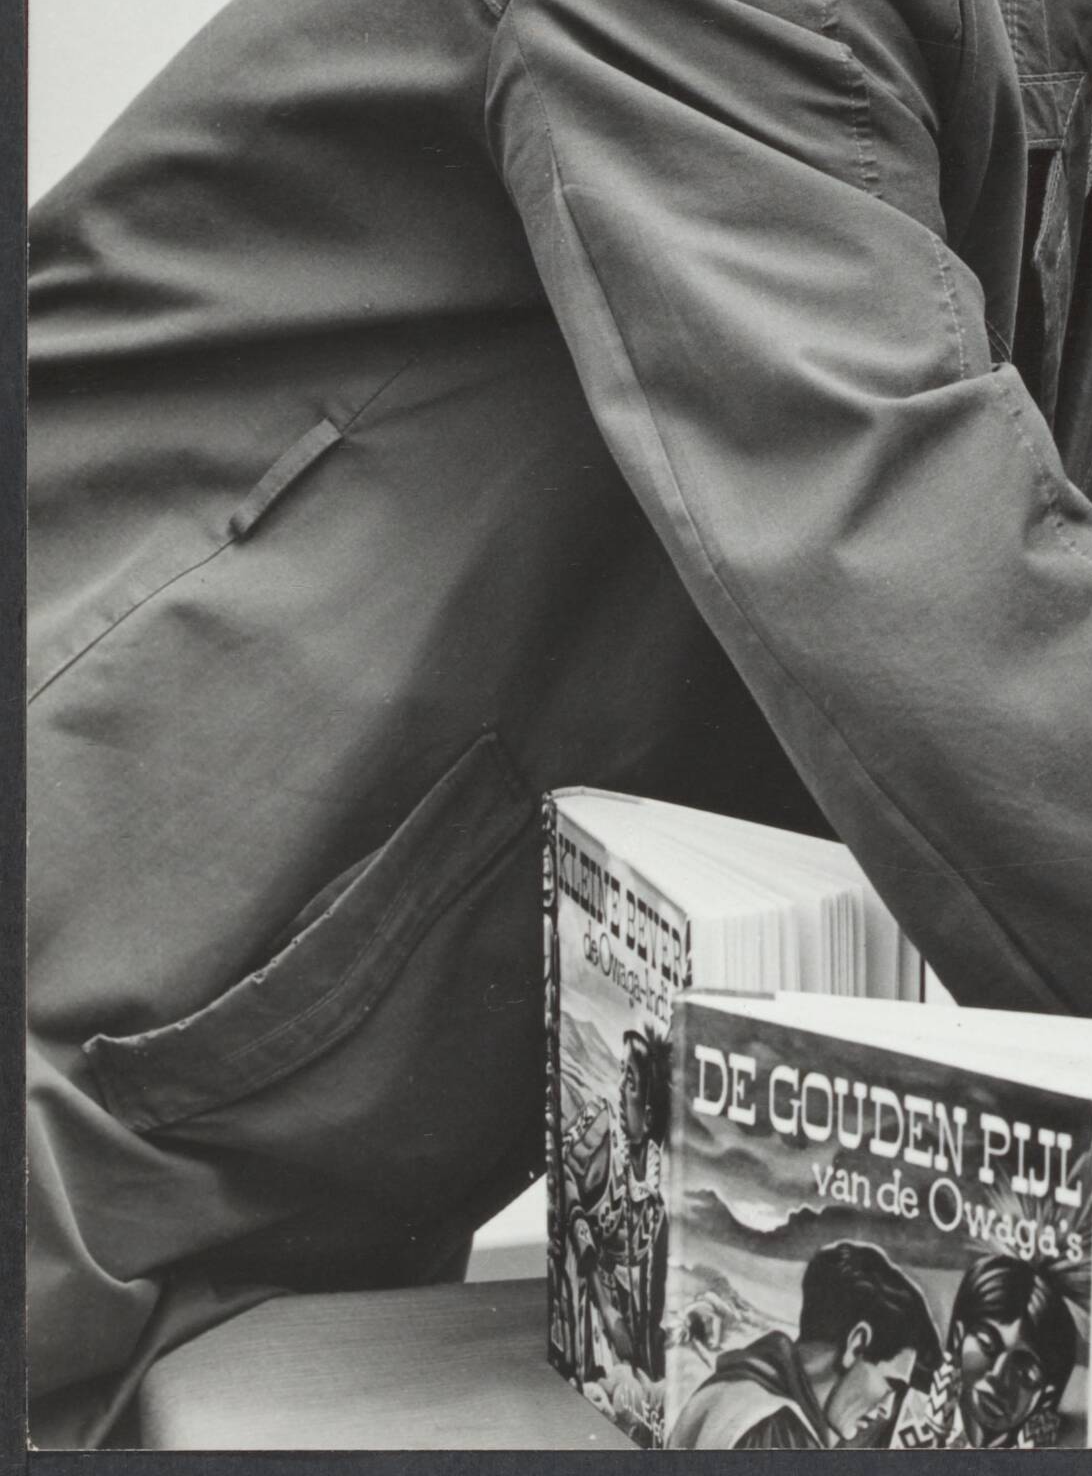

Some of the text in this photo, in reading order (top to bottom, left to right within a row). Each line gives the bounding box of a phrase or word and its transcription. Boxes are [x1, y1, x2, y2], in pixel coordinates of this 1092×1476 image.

[558, 831, 621, 940] KLEINE
[625, 887, 683, 989] BEVER
[583, 919, 599, 968] de
[692, 1043, 1084, 1208] DE GOUDEN PIJL
[812, 1162, 1085, 1263] van de Owaga's
